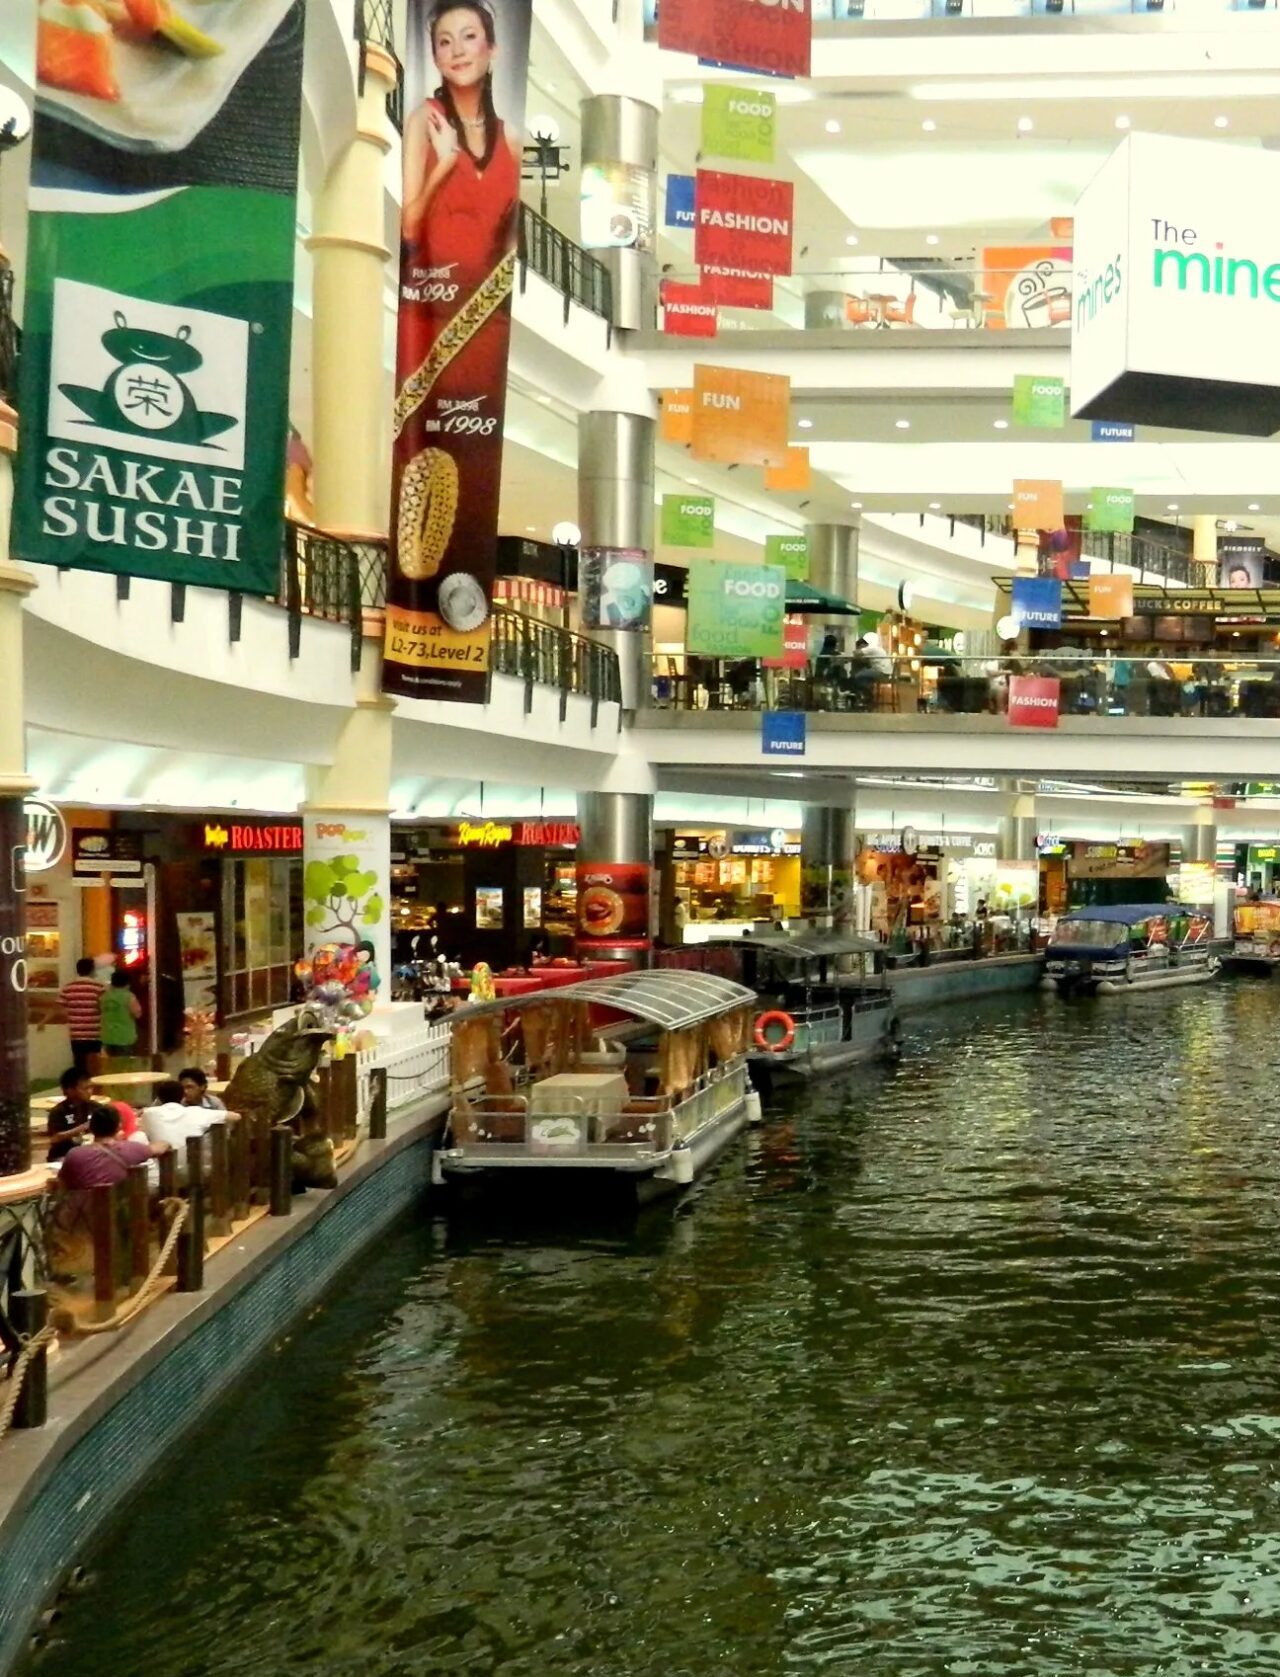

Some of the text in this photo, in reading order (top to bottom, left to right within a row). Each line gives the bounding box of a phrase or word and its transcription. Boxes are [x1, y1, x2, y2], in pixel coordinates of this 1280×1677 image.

[728, 100, 772, 118] FOOD
[676, 211, 697, 222] FUT
[700, 209, 788, 236] FASHION
[1151, 217, 1197, 246] The
[402, 283, 460, 302] RM 998
[1076, 253, 1121, 334] mines
[666, 303, 716, 317] FASHION
[1030, 384, 1063, 397] FOOD
[702, 392, 741, 411] FUN
[667, 403, 690, 415] FUN
[425, 415, 497, 435] RM 1998
[1100, 426, 1133, 438] FUTURE
[45, 447, 243, 515] SAKAE
[1017, 491, 1039, 502] FUN
[1105, 494, 1133, 505] FOOD
[680, 504, 713, 517] FOOD
[42, 496, 242, 562] SUSHI
[780, 542, 807, 553] FOOD
[724, 579, 780, 599] FOOD
[1173, 599, 1222, 611] COFFEE
[1020, 611, 1059, 622] FUTURE
[412, 625, 428, 636] us
[429, 625, 443, 637] at
[473, 646, 485, 663] 2
[1011, 695, 1058, 708] FASHION
[770, 740, 804, 751] FUTURE
[231, 825, 304, 850] ROASTER
[521, 822, 581, 846] ROASTERS
